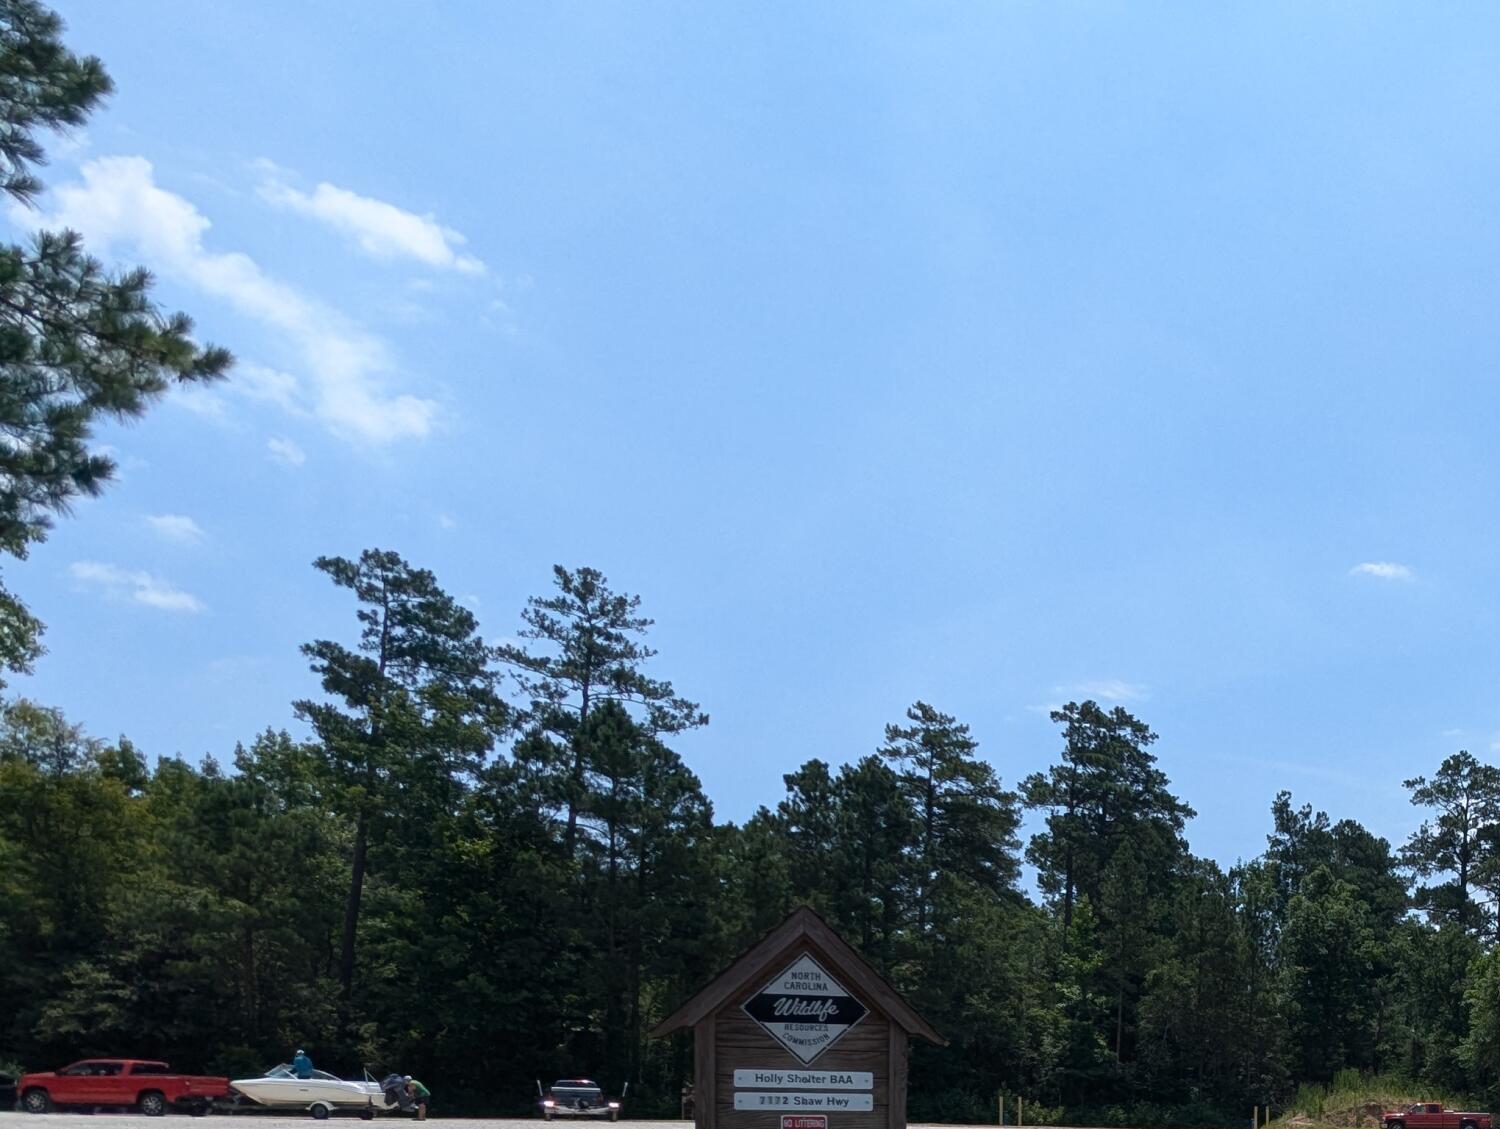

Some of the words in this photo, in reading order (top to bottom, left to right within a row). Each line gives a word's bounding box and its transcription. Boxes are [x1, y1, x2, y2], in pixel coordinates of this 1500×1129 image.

[791, 972, 821, 981] NORTH
[784, 982, 829, 991] CAROLINA
[773, 997, 840, 1022] Wildlife
[784, 1024, 829, 1032] RESOURCES
[782, 1032, 830, 1046] COMMISSION
[755, 1073, 784, 1084] Holly
[787, 1073, 827, 1084] Shelter
[830, 1074, 853, 1084] BAA
[793, 1096, 823, 1106] Shaw
[827, 1096, 849, 1107] Hwy
